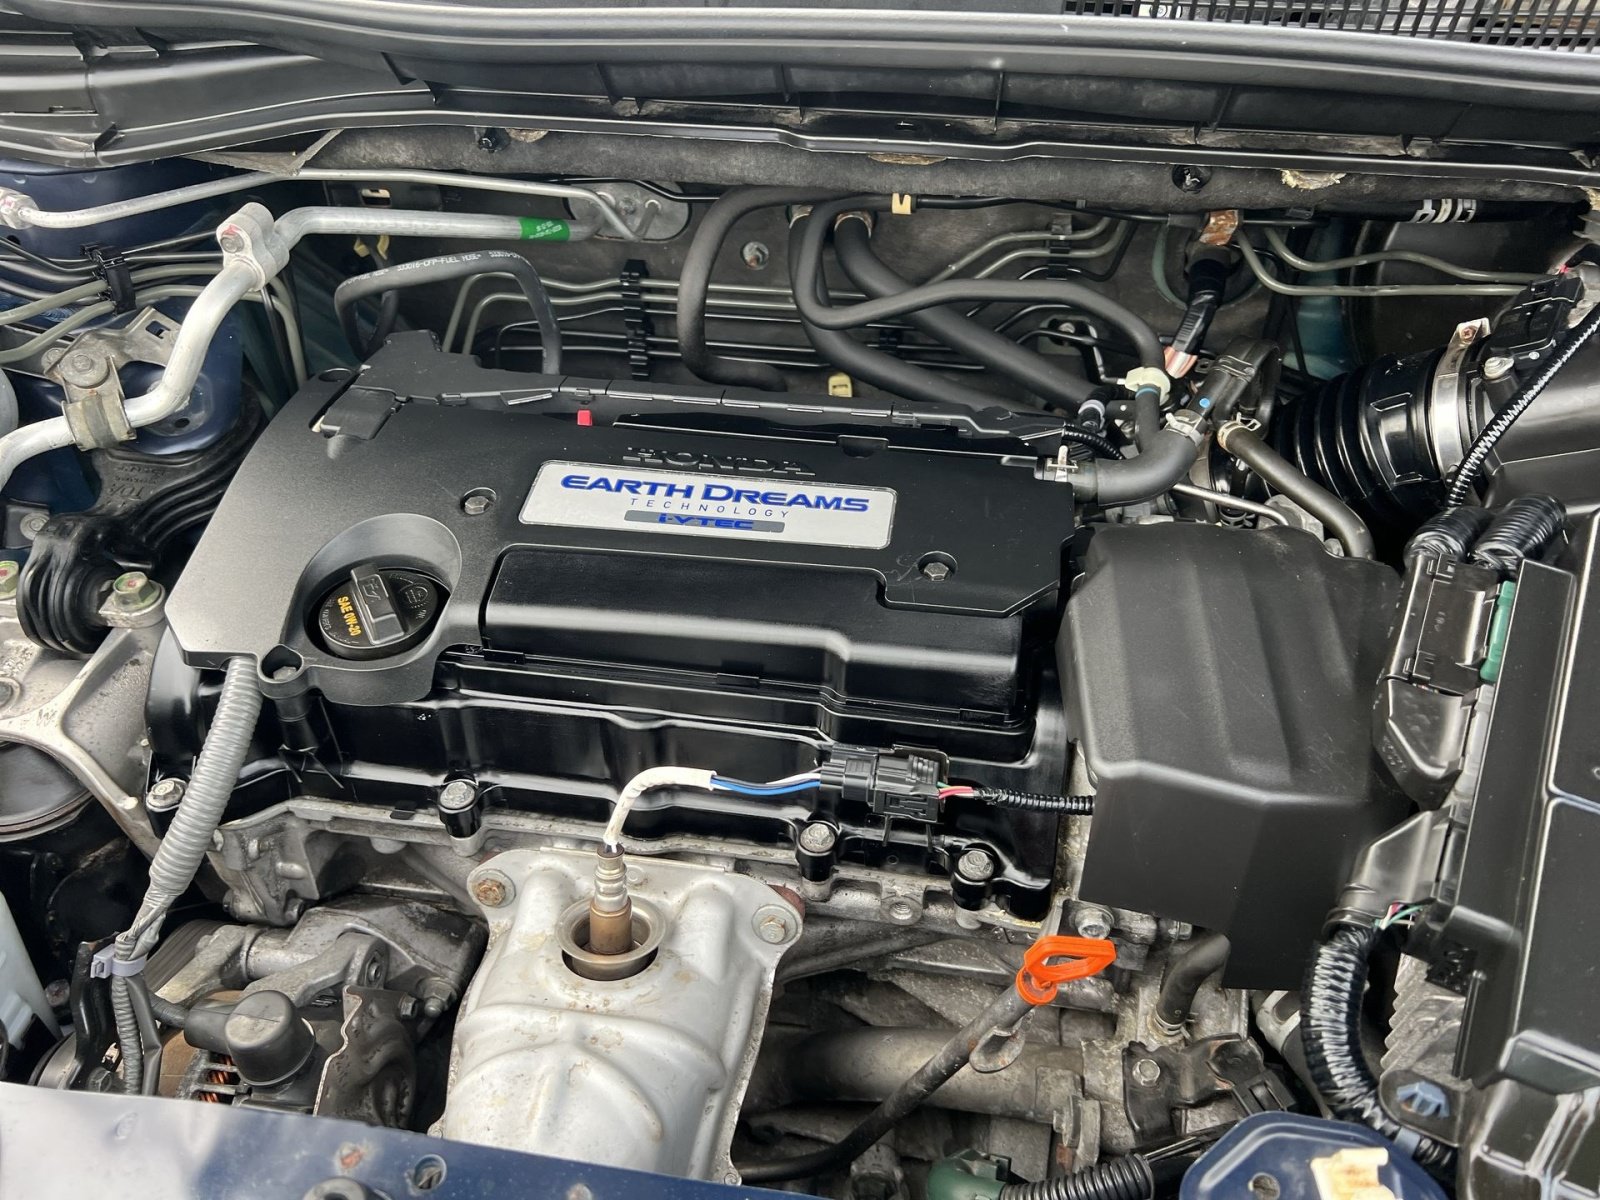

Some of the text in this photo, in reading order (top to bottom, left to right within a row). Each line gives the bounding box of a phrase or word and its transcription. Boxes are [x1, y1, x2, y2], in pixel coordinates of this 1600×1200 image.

[622, 446, 816, 476] HONDA
[560, 474, 870, 513] EARTH DREAMS
[630, 498, 789, 518] TECHNOLOGY
[658, 512, 754, 530] i-VTEC
[337, 596, 353, 614] SAE
[343, 612, 361, 636] 0W-20
